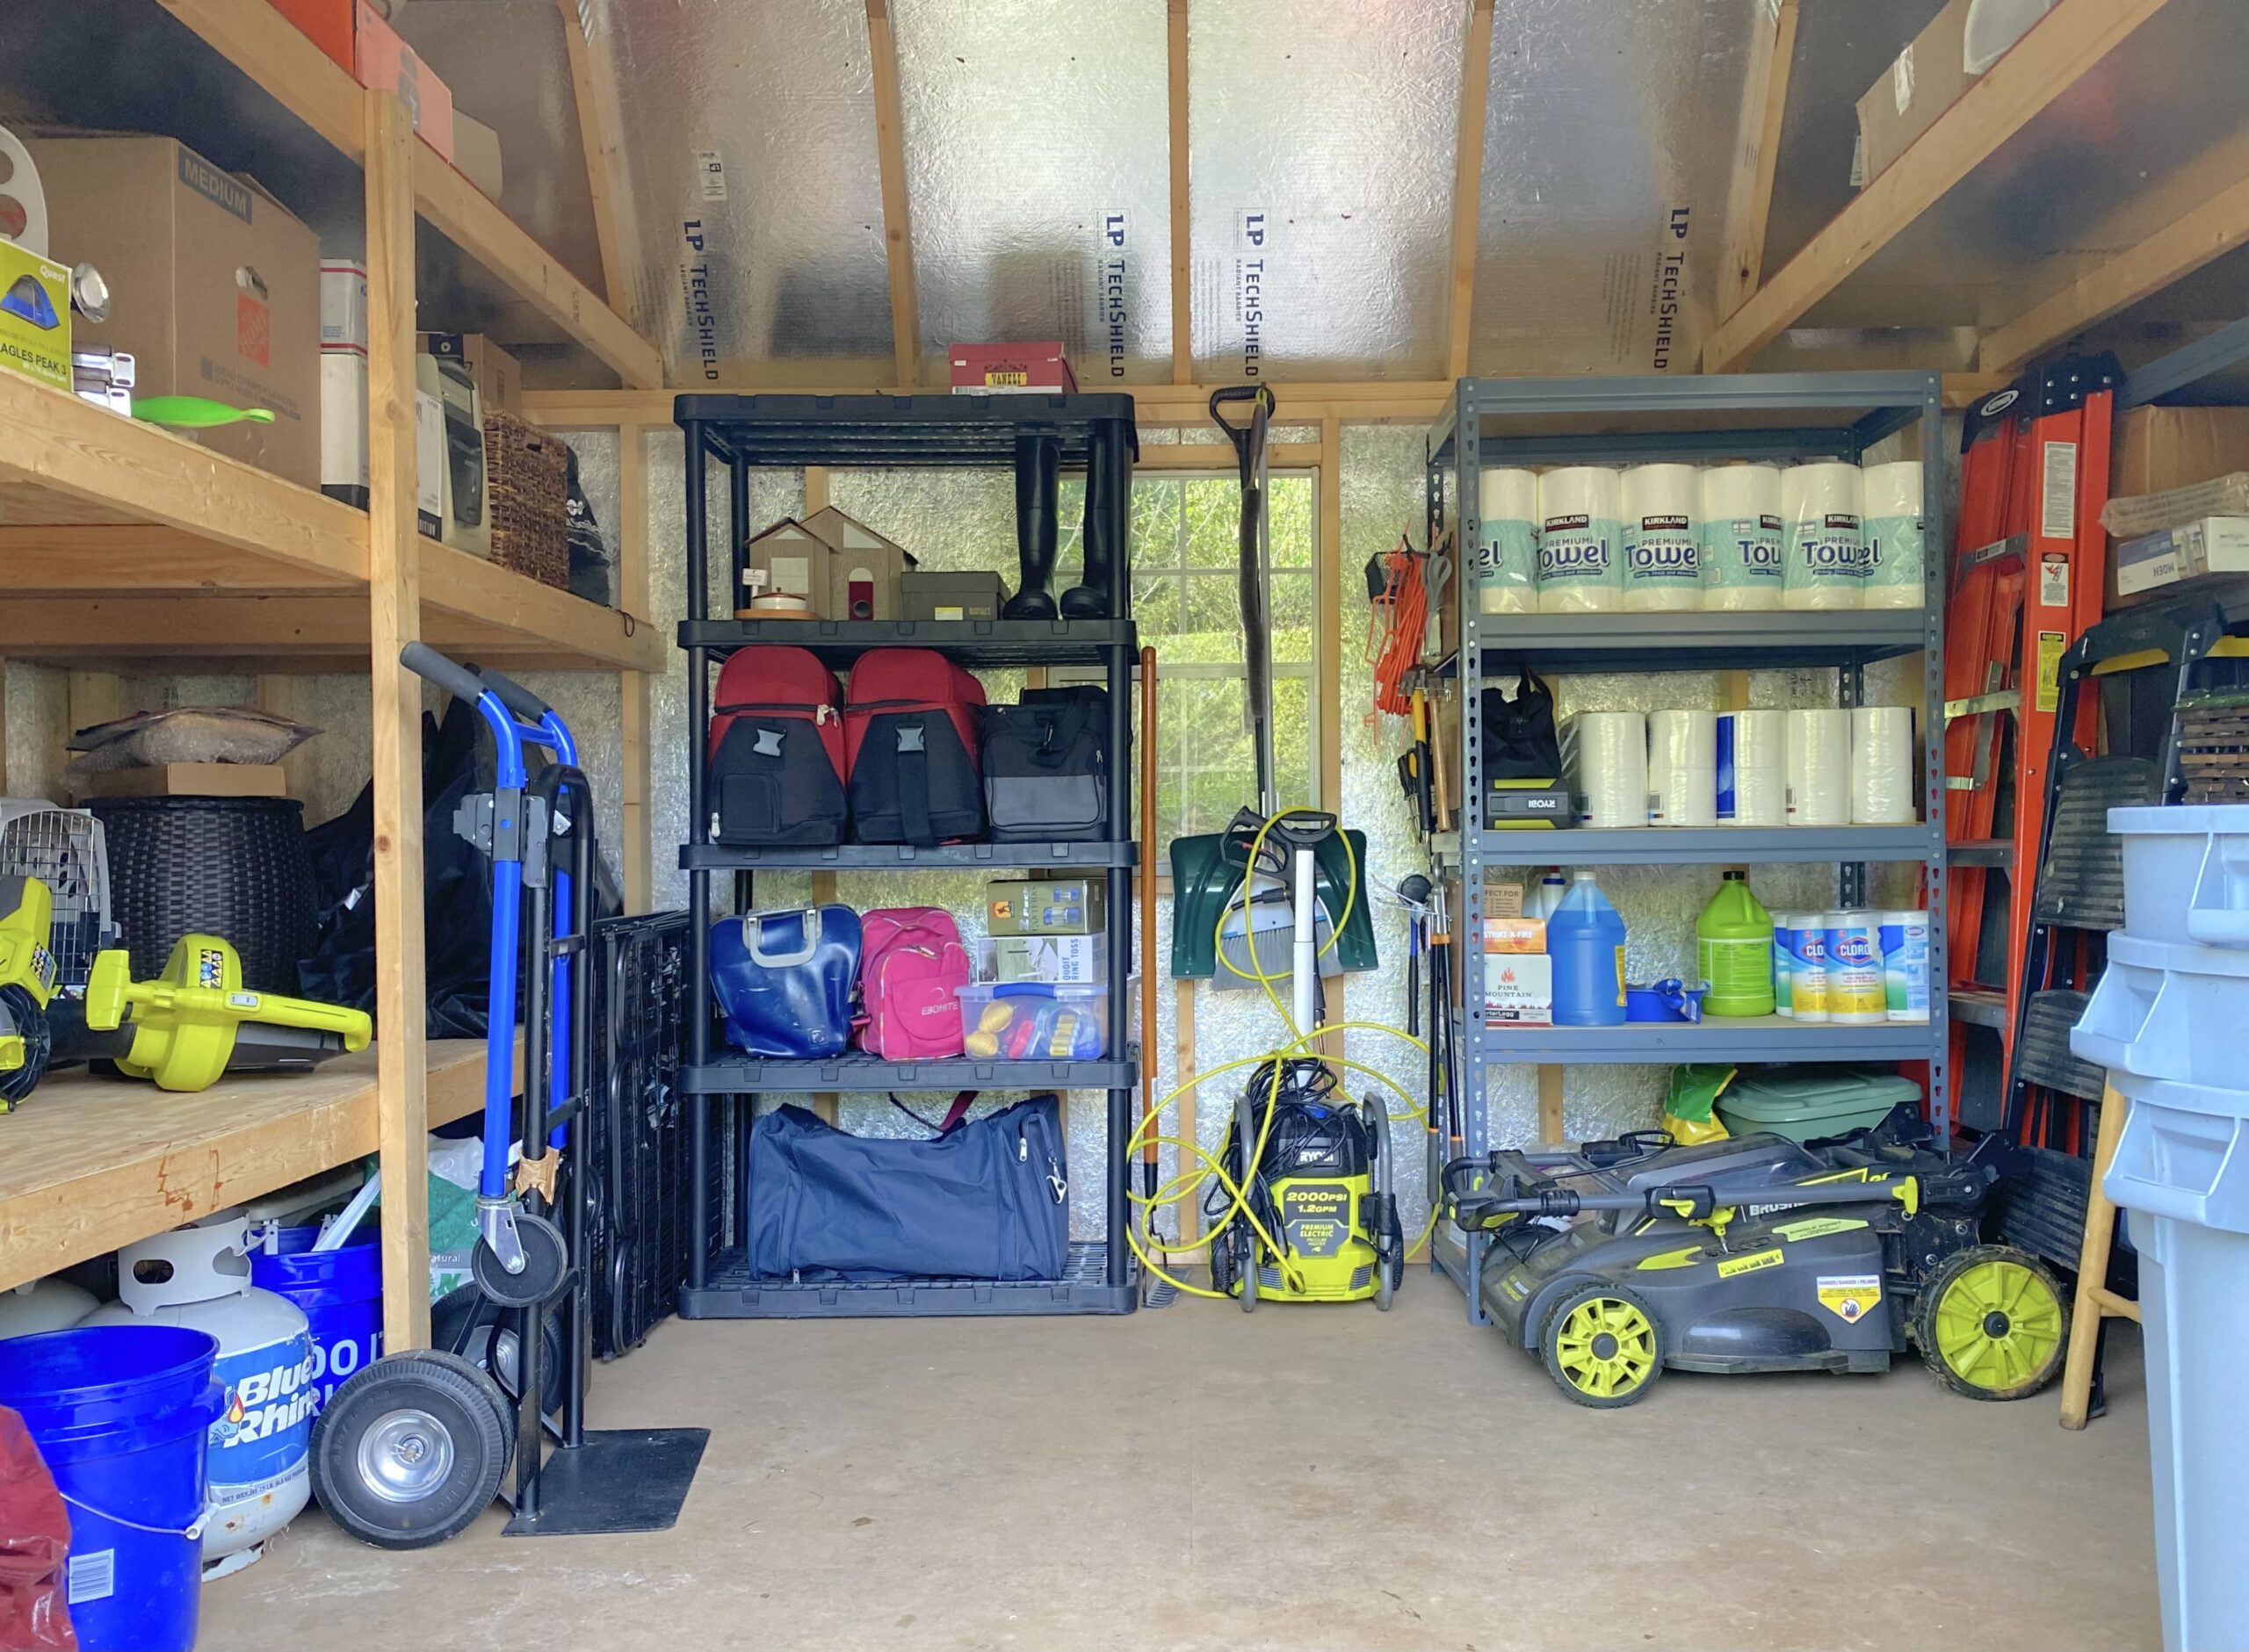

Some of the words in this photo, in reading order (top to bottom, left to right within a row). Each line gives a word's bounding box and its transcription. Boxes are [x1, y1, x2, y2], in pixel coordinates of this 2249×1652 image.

[184, 158, 247, 214] MEDIUM
[1106, 214, 1124, 246] LP
[1246, 214, 1264, 246] LP
[1670, 207, 1689, 238] LP
[683, 220, 704, 251] LP
[40, 264, 66, 284] Quest
[0, 342, 33, 364] AGLES
[35, 355, 60, 374] PEAK
[61, 365, 67, 375] 3
[991, 372, 1021, 385] VANELI
[1546, 516, 1588, 528] KIRKLAND
[1644, 516, 1688, 525] KIRKLAND
[1545, 537, 1591, 547] PREMIUM
[1625, 542, 1702, 569] Towel
[2152, 562, 2175, 577] MOEN
[1528, 799, 1556, 809] RYOBI
[1070, 938, 1080, 958] TOSS
[1806, 945, 1825, 956] CLO
[1840, 944, 1871, 956] CLORO
[1061, 956, 1071, 981] QUOIT
[1071, 960, 1080, 981] RING
[921, 1000, 958, 1016] EBONITE
[238, 1355, 312, 1408] Blue
[222, 1390, 312, 1449] Rhin
[235, 1489, 257, 1500] WEIGHT
